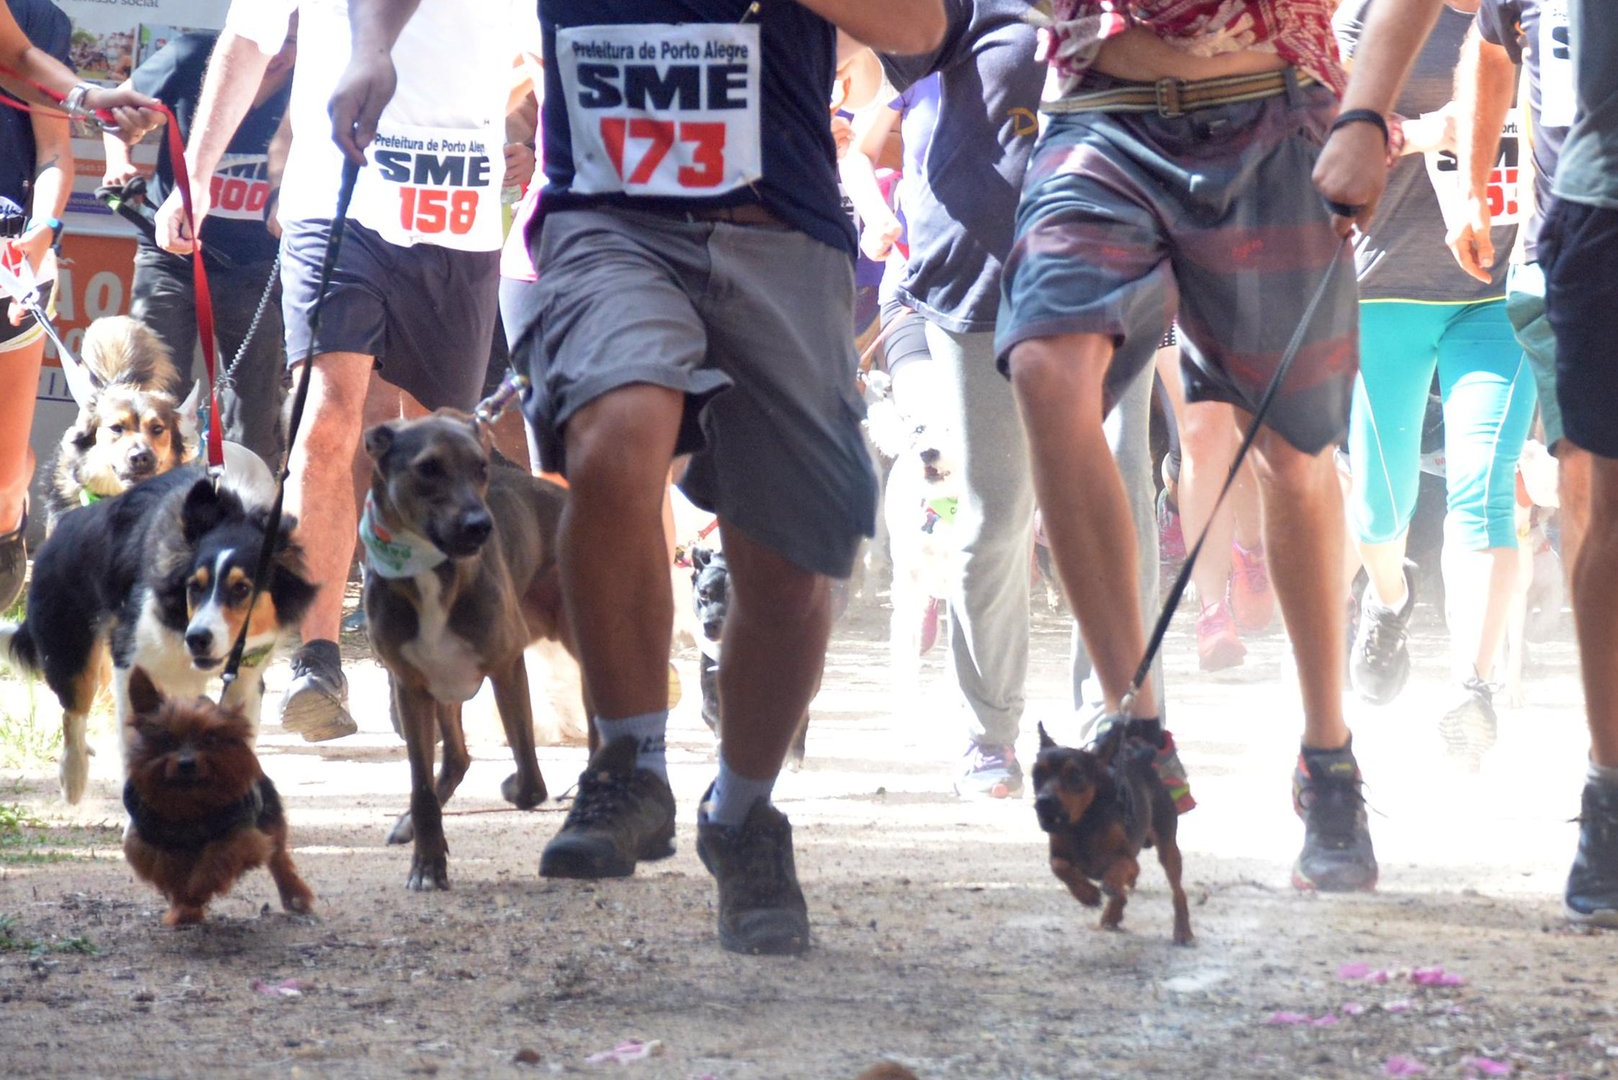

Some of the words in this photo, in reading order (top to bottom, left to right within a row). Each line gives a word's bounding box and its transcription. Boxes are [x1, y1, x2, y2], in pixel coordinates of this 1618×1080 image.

[572, 41, 634, 60] Prefeitura
[639, 41, 656, 59] de
[661, 41, 700, 60] Porto
[704, 41, 749, 62] Alegre
[577, 63, 748, 111] SME
[374, 133, 424, 151] Prefeitura
[427, 139, 438, 152] de
[441, 139, 466, 152] Porto
[600, 117, 726, 188] 173
[374, 149, 491, 187] SME
[400, 186, 479, 234] 158
